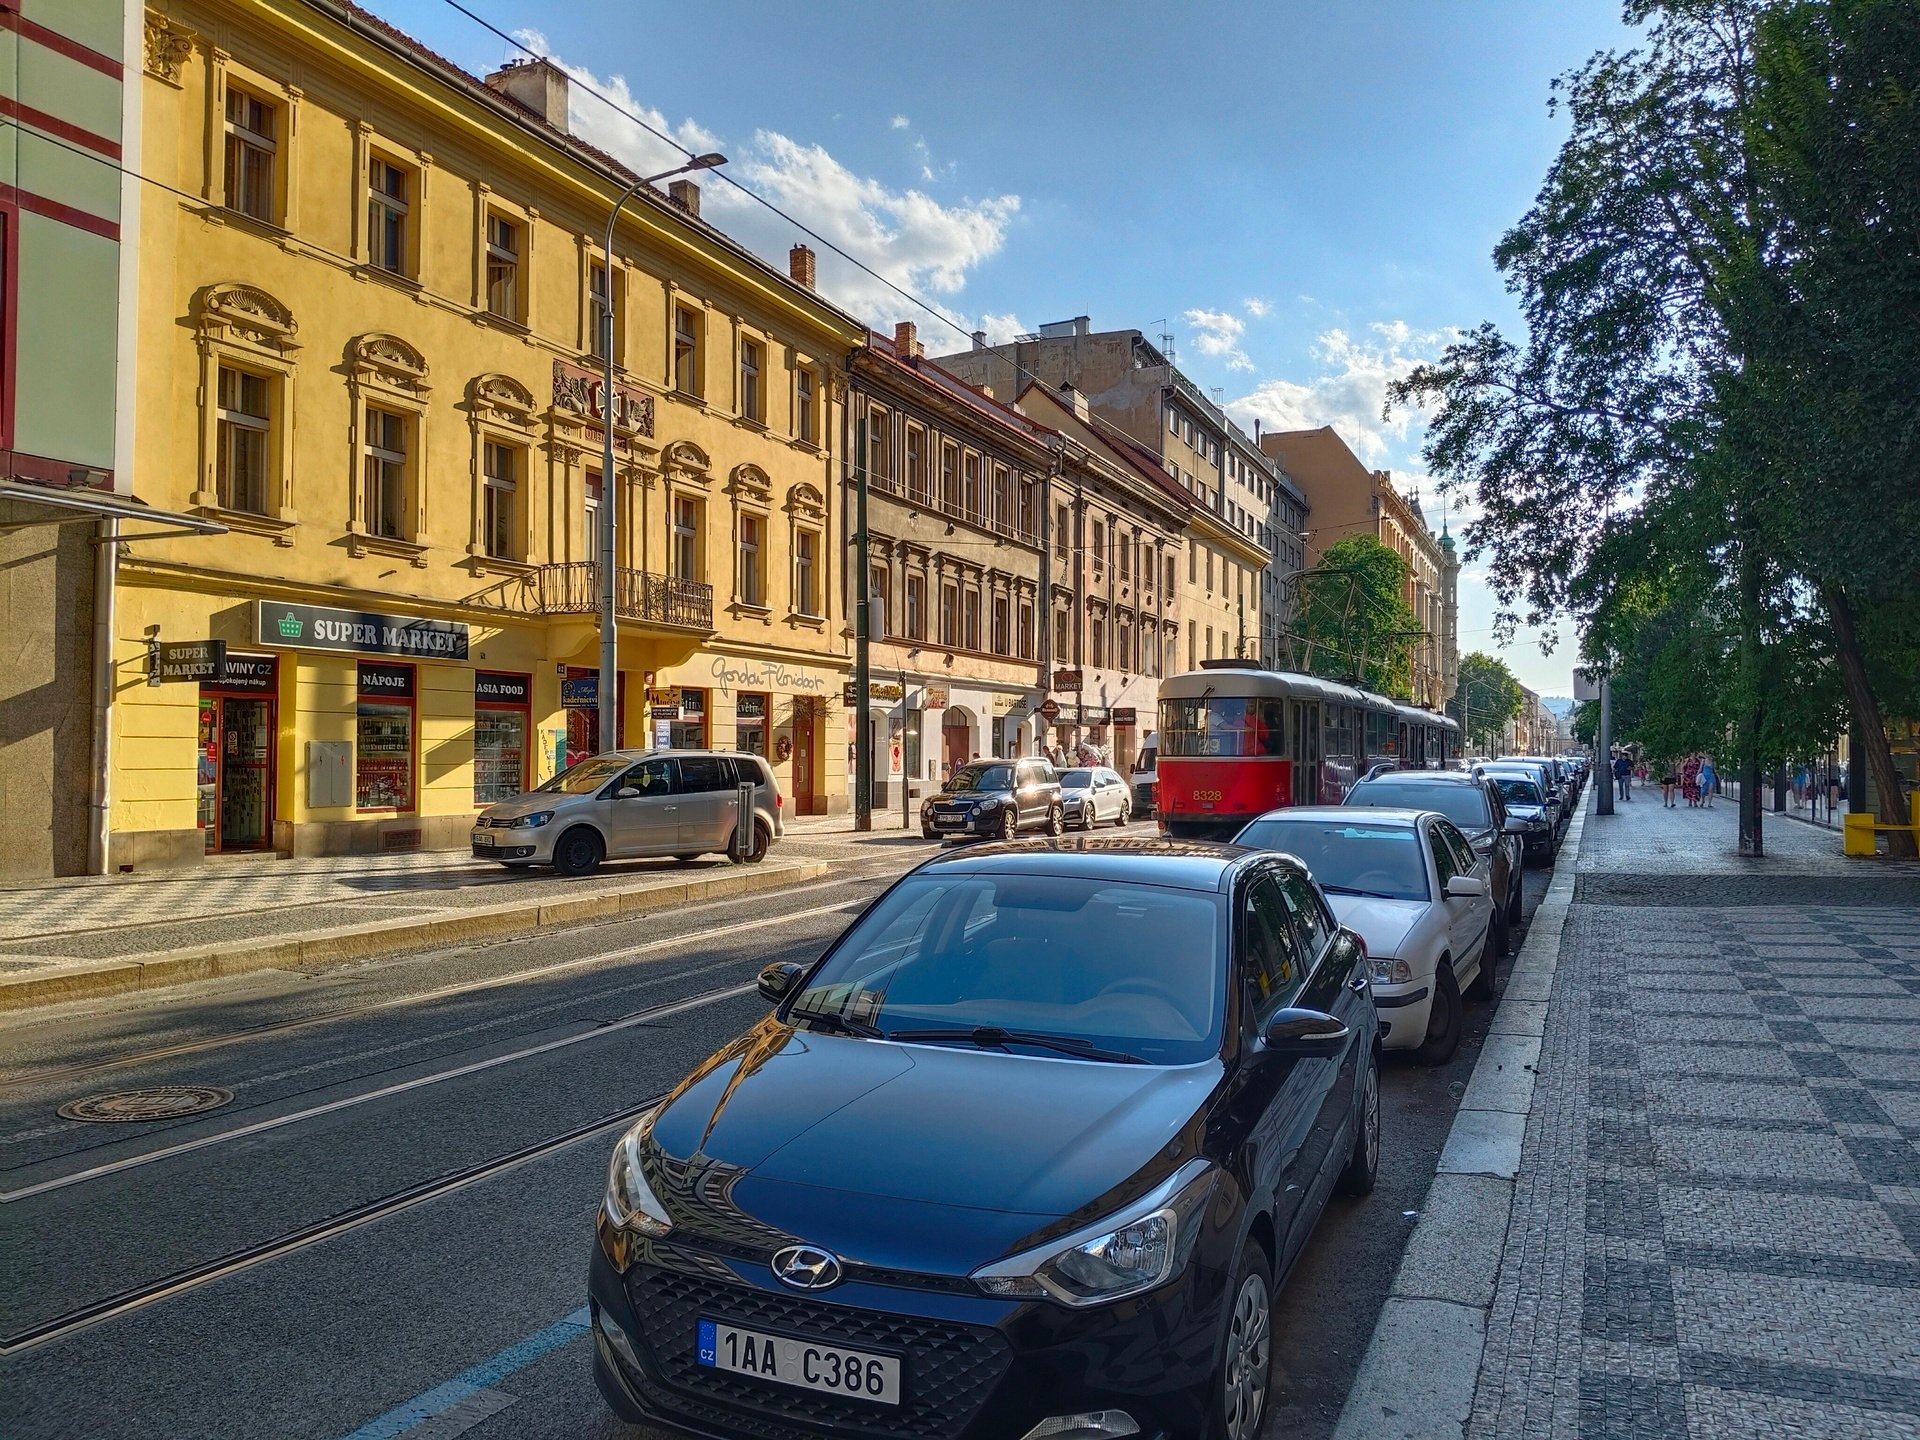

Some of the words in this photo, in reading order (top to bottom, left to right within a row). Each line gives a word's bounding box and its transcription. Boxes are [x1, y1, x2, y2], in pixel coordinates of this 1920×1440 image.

[313, 618, 378, 645] SUPER
[382, 626, 457, 653] MARKET
[168, 646, 209, 661] SUPER
[163, 662, 215, 677] MARKET
[256, 664, 272, 675] CZ
[362, 673, 405, 688] NÁPOJE
[1055, 682, 1082, 690] MARKET
[476, 683, 499, 695] ASIA
[499, 684, 524, 696] FOOD
[1192, 790, 1222, 801] 8328
[700, 1348, 714, 1361] CZ
[725, 1332, 777, 1377] 1AA
[803, 1348, 884, 1396] C386
